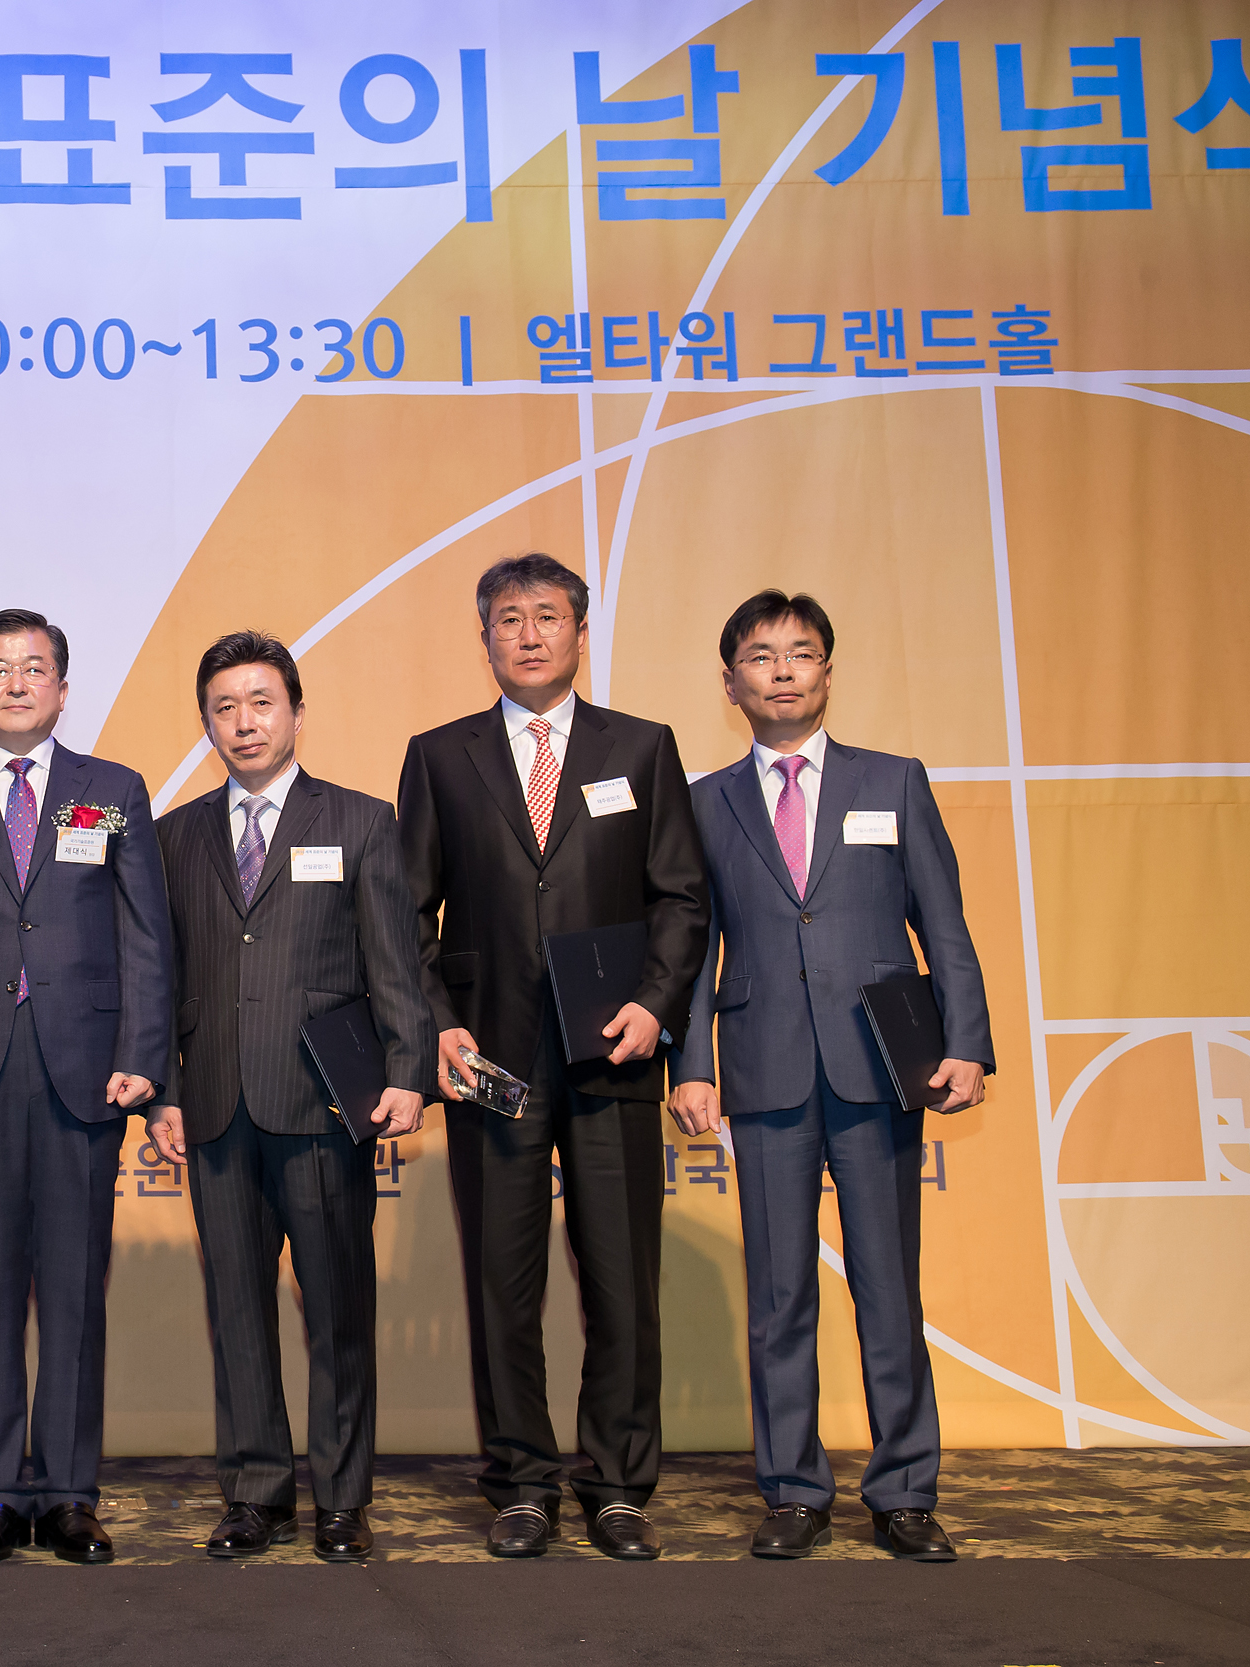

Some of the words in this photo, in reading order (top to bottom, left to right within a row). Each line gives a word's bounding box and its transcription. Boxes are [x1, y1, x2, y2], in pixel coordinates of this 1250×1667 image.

[572, 43, 740, 221] 날
[527, 310, 739, 385] 엘타워
[769, 303, 1059, 379] 그랜드홀
